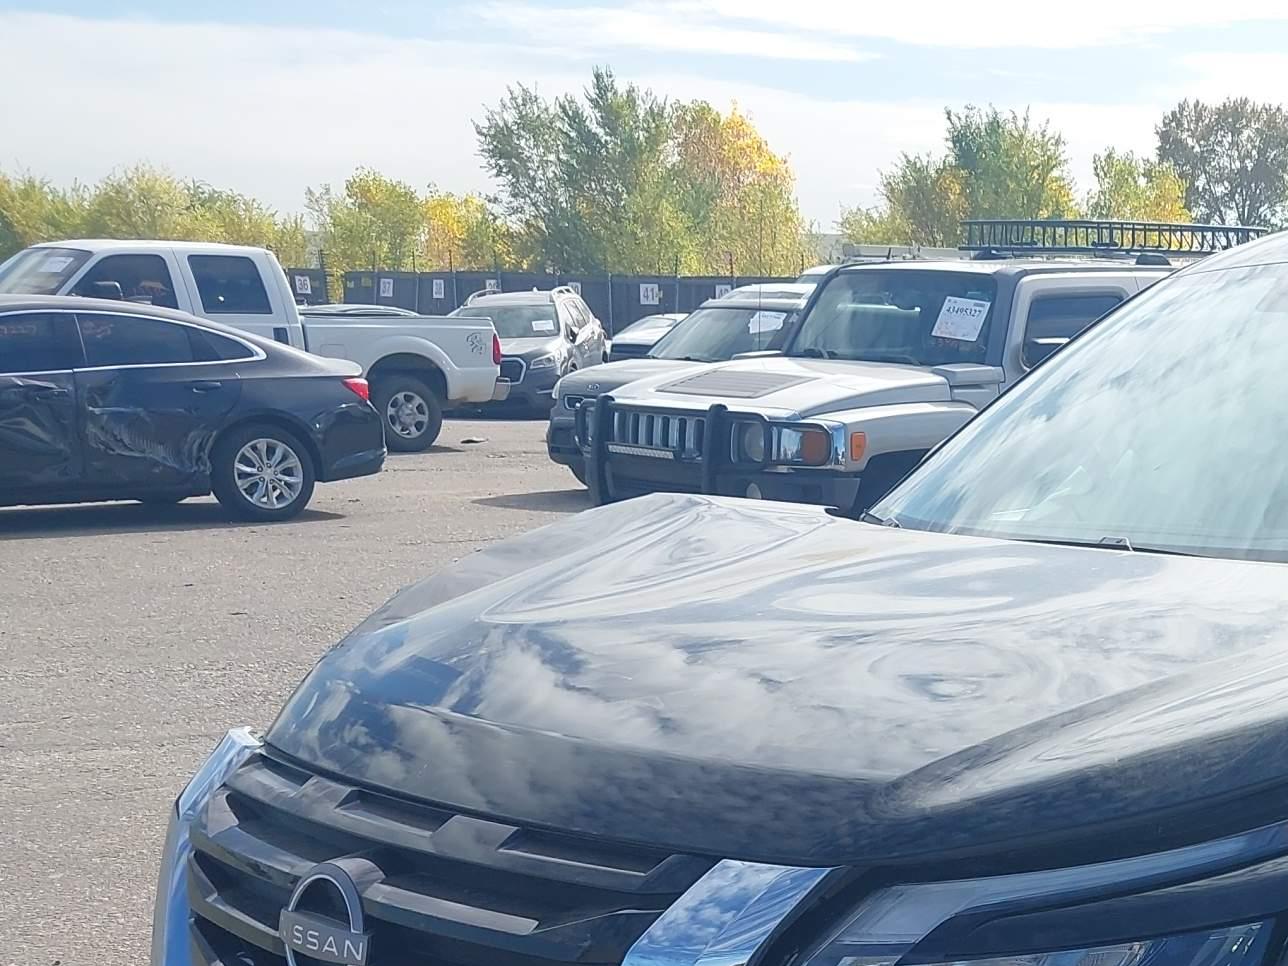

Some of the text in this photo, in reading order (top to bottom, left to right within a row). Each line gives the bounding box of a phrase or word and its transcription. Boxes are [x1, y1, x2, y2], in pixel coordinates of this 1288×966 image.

[297, 278, 308, 291] 36
[382, 281, 391, 295] 37
[643, 287, 656, 301] 41
[288, 923, 363, 961] SSAN
